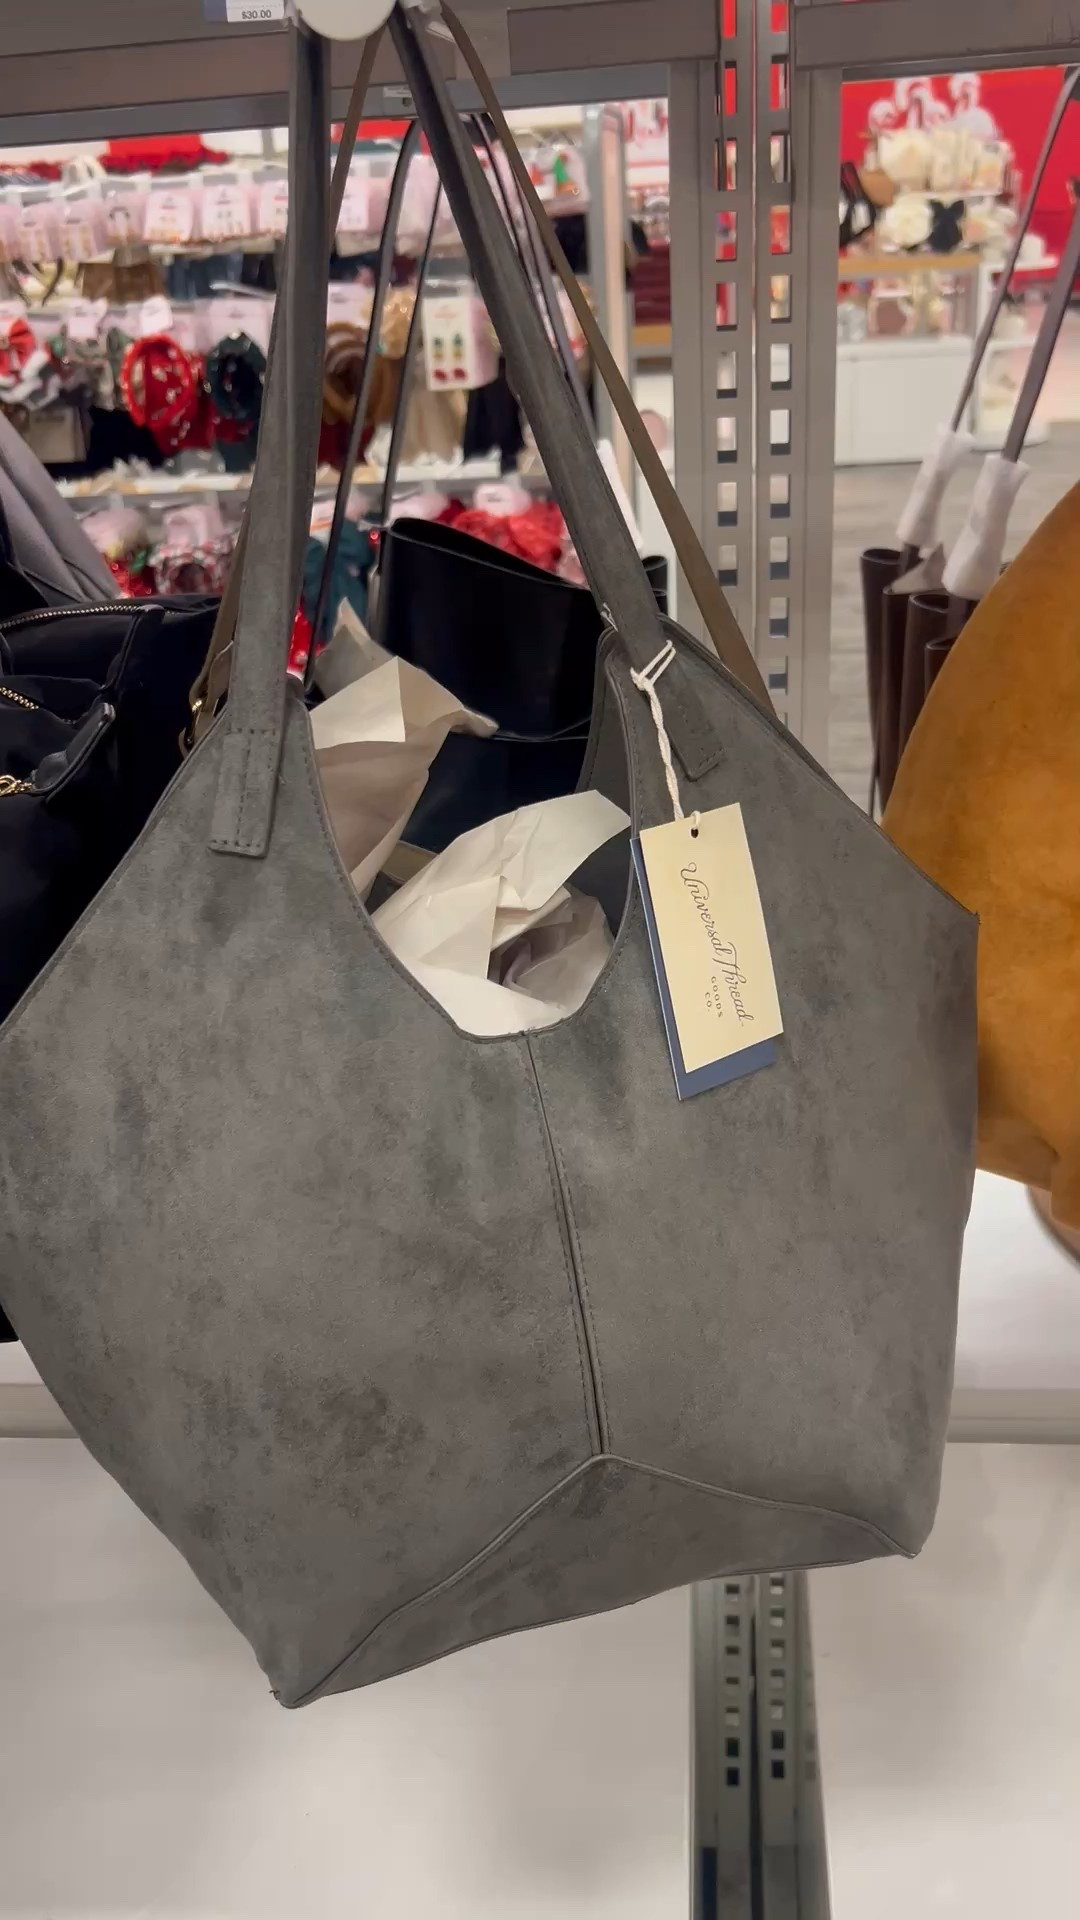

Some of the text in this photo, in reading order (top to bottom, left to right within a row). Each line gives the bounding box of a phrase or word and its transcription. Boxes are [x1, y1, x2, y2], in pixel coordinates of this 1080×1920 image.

[241, 9, 272, 19] $30.00
[680, 862, 732, 956] Universal
[711, 976, 722, 1018] GOODS
